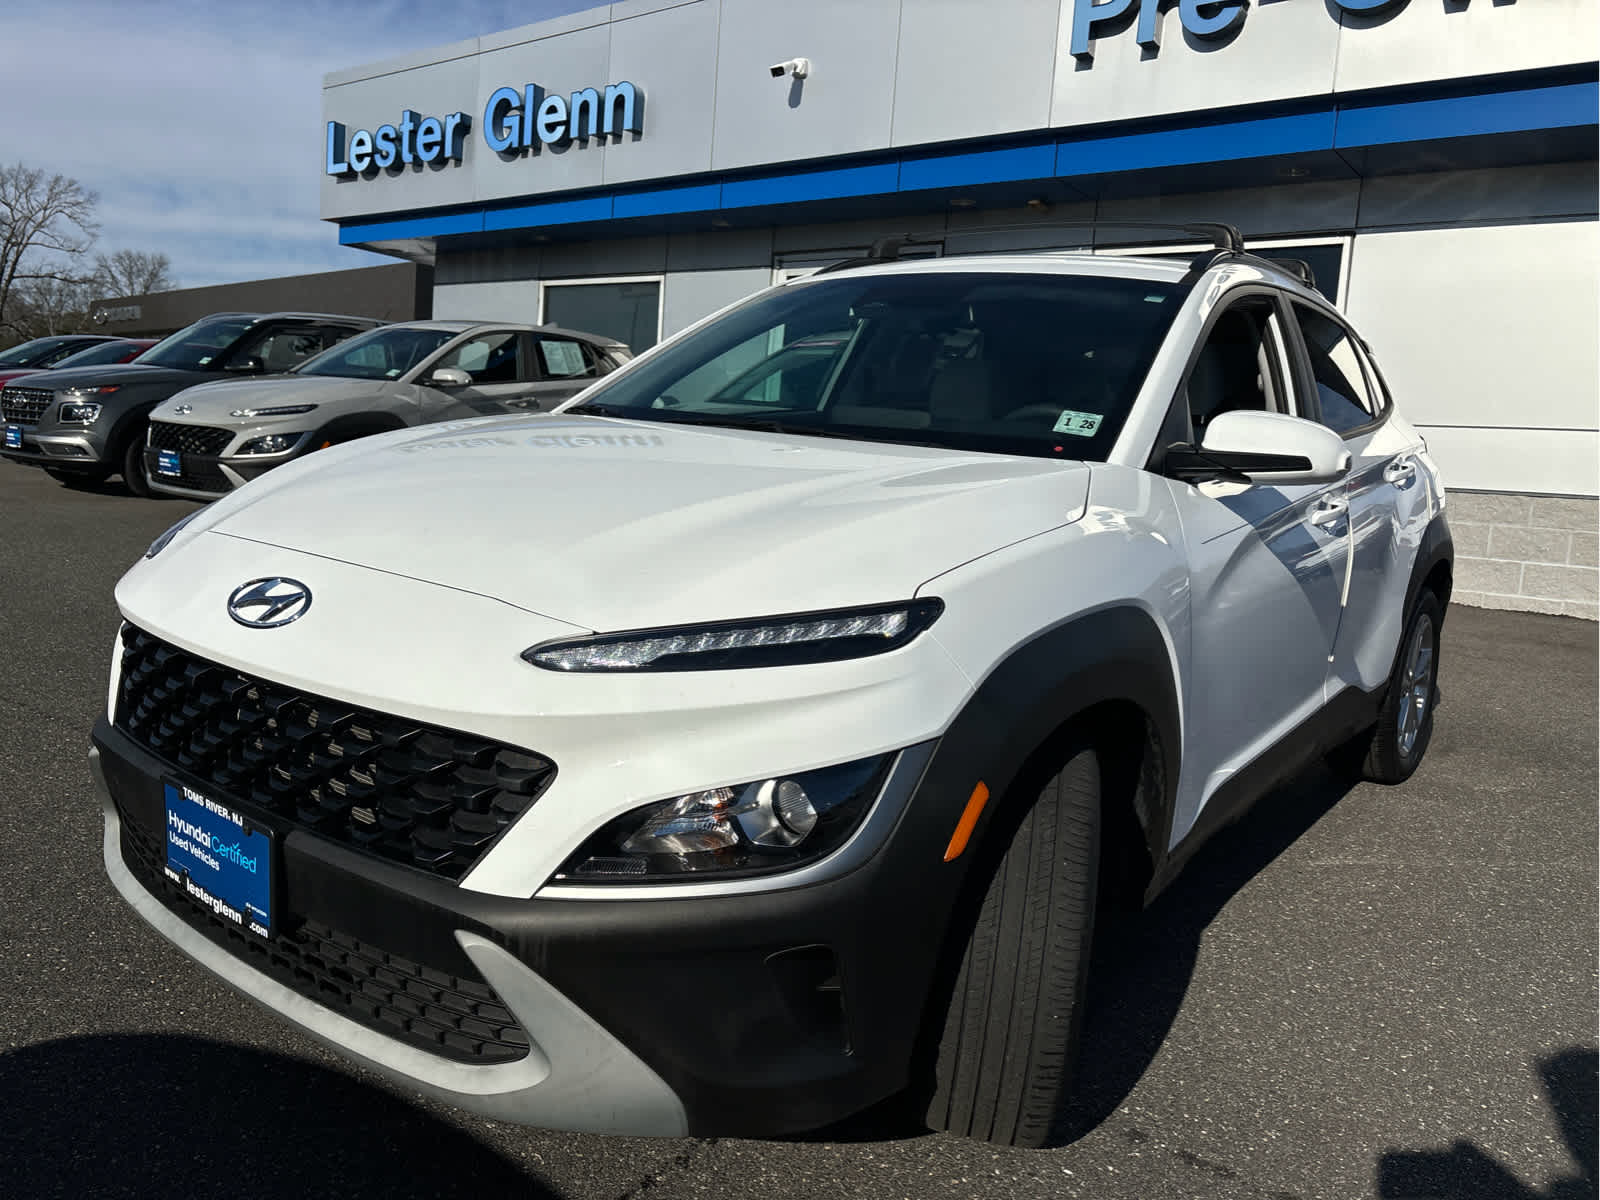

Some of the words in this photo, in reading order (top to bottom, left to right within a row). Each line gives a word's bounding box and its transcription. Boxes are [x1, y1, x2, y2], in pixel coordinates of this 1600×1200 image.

[326, 109, 472, 177] Lester
[484, 81, 643, 153] Glenn
[1064, 417, 1072, 426] 1
[1079, 420, 1096, 429] 28
[182, 786, 204, 807] TOMS
[232, 812, 243, 827] NJ
[168, 809, 211, 848] Hyundai
[211, 835, 257, 874] Certified
[169, 830, 189, 852] Used
[188, 841, 220, 872] Vehicles
[186, 877, 242, 925] lesterglenn
[249, 921, 268, 939] .com
